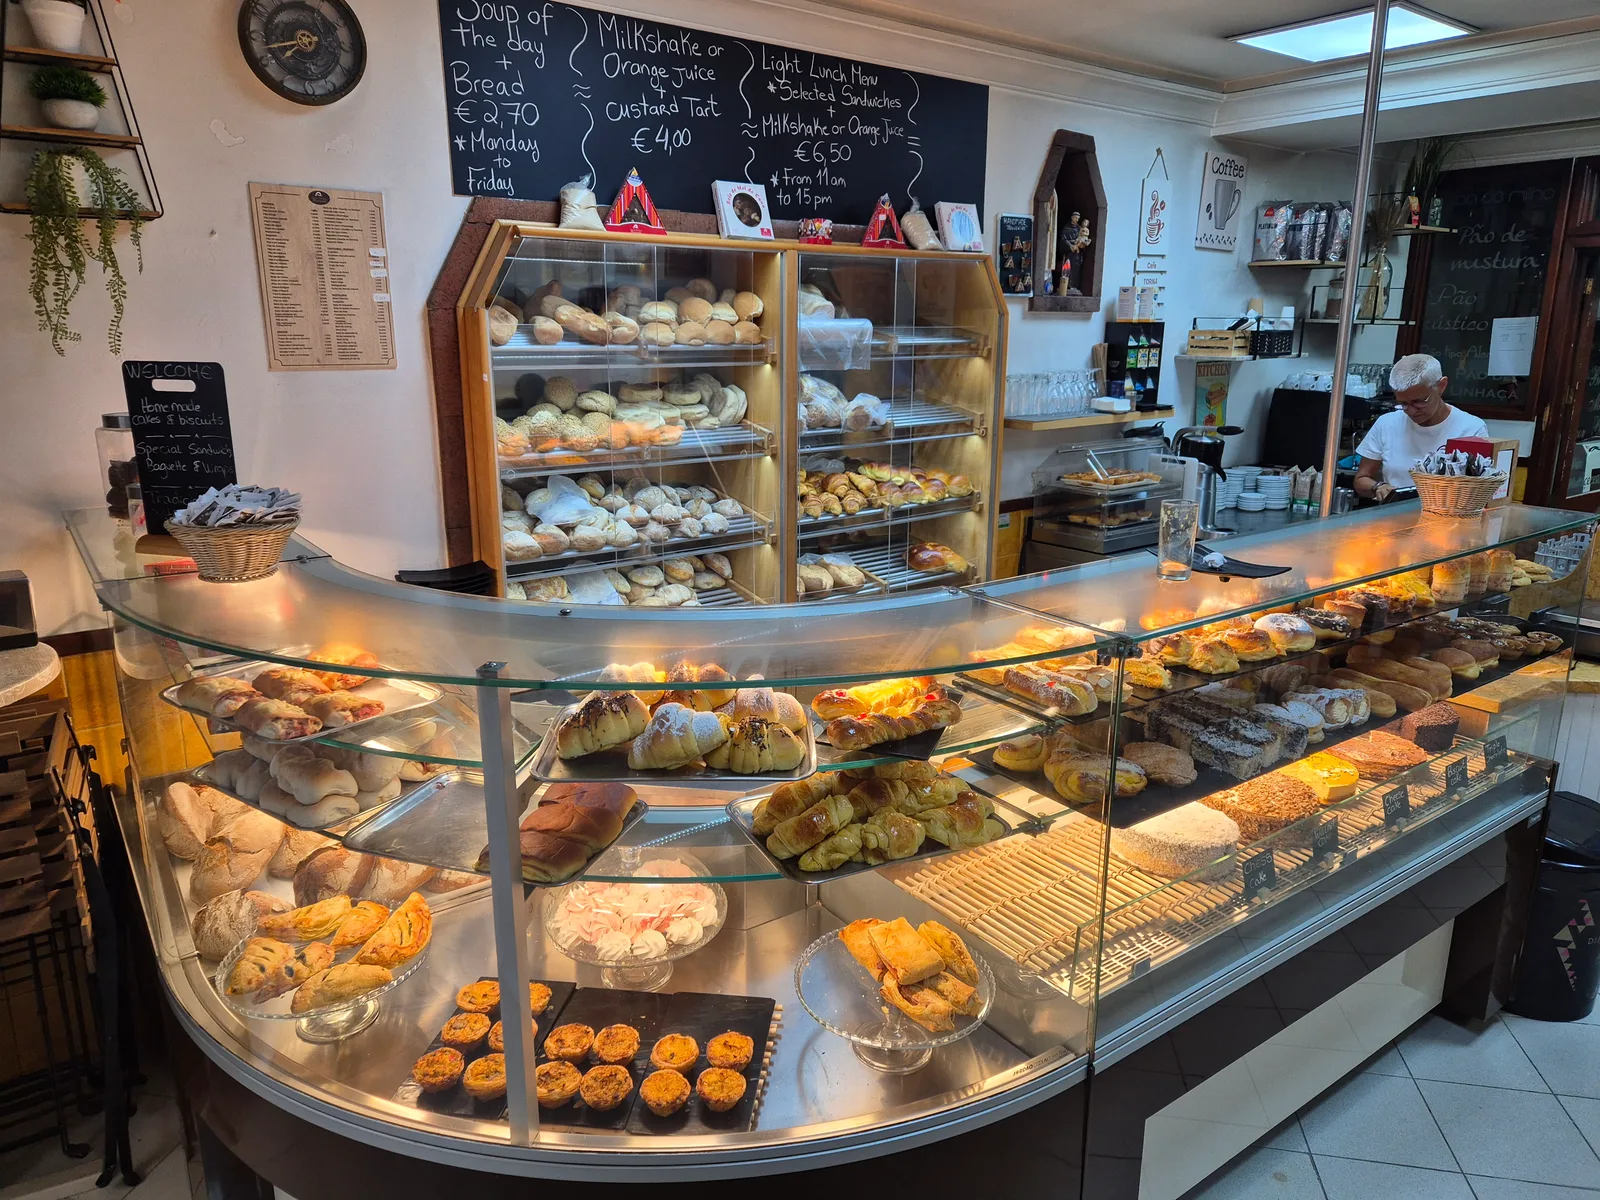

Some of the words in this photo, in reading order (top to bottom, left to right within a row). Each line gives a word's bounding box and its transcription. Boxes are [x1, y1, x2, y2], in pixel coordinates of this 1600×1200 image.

[528, 3, 554, 36] of
[451, 23, 497, 47] the
[507, 25, 545, 69] day
[598, 14, 702, 56] Milkshake
[708, 44, 724, 57] or
[603, 52, 669, 89] Orange
[762, 44, 804, 82] Light
[810, 53, 847, 82] Lunch
[851, 65, 878, 87] Menu
[450, 61, 525, 96] Bread
[682, 94, 722, 118] Tart
[841, 85, 902, 110] Sandwiches
[762, 113, 830, 137] Milkshake
[832, 124, 845, 136] or
[849, 115, 881, 146] Orange
[494, 153, 511, 168] to
[1212, 156, 1244, 178] Coffee
[467, 167, 514, 196] Friday
[777, 190, 790, 206] to
[1500, 223, 1527, 243] de
[124, 363, 213, 380] WELCOME
[1197, 363, 1230, 377] KITCHEN
[178, 412, 223, 426] biscuits
[136, 441, 183, 459] Special
[146, 457, 187, 480] Baguette
[1385, 791, 1404, 807] Cheese
